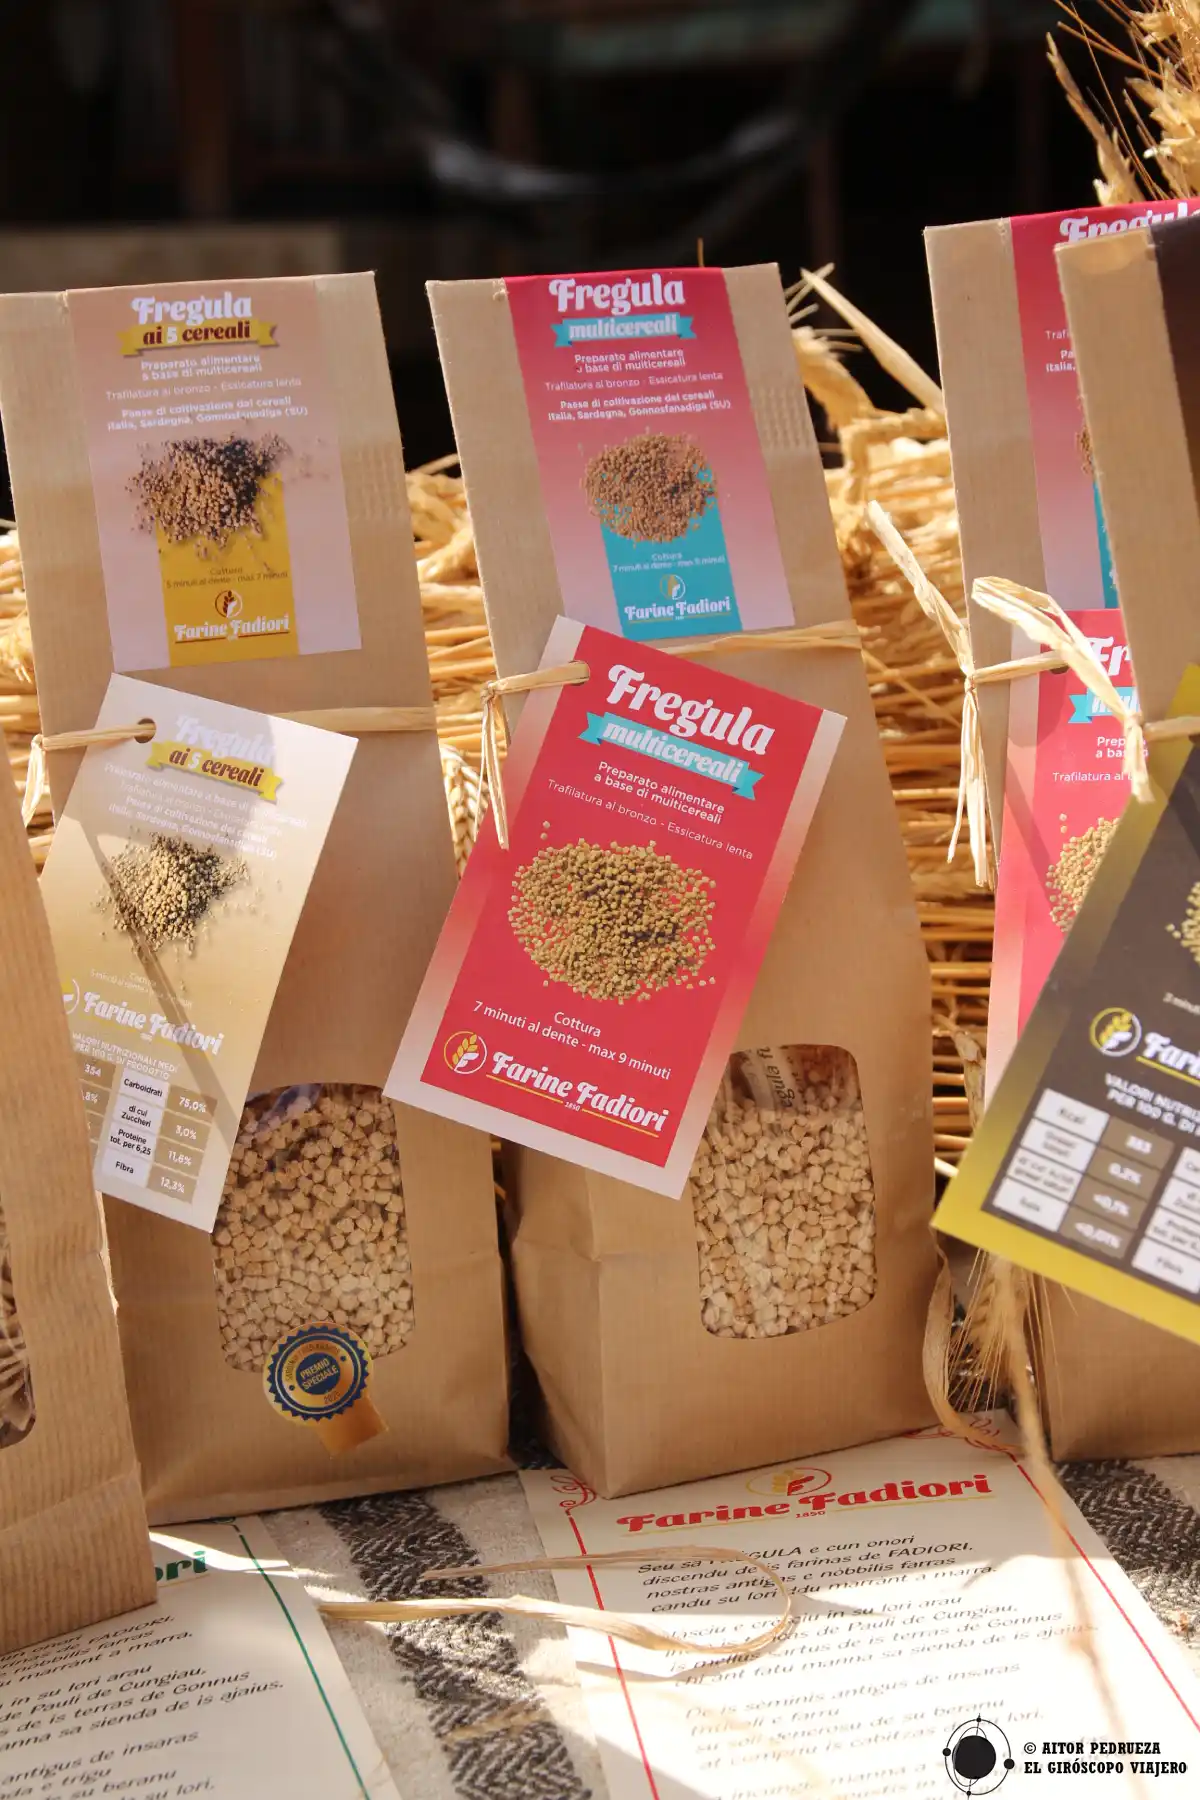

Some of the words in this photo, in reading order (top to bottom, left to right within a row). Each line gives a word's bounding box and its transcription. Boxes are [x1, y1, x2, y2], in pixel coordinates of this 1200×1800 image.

[130, 291, 252, 325] Fregula
[549, 273, 686, 316] Fregula
[143, 326, 162, 344] ai
[167, 327, 177, 343] 5
[182, 320, 250, 342] cereali
[569, 314, 678, 339] multicereali
[141, 358, 197, 372] Preparato
[201, 353, 260, 366] alimentare
[574, 353, 626, 365] Preparato
[629, 348, 684, 361] alimentare
[585, 363, 609, 373] base
[612, 361, 622, 371] di
[625, 357, 686, 370] multicereali
[606, 377, 640, 388] bronzo
[649, 373, 697, 385] Essicatura
[699, 371, 723, 381] lenta
[624, 603, 674, 621] Farine
[675, 596, 731, 617] Fadiori
[174, 621, 229, 642] Farine
[230, 613, 290, 636] Fadiori
[607, 664, 776, 755] Fregula
[602, 721, 744, 784] multicereali
[169, 748, 191, 766] ai
[201, 758, 265, 787] cereali
[1053, 771, 1111, 782] Trafilatura
[1114, 771, 1124, 781] al
[594, 773, 602, 782] a
[604, 774, 633, 793] base
[636, 787, 649, 799] di
[651, 792, 722, 825] multicereali
[599, 760, 658, 790] Preparato
[661, 784, 725, 815] alimentare
[548, 778, 603, 807] Trafilatura
[605, 800, 616, 812] al
[617, 802, 657, 826] bronzo
[667, 821, 724, 849] Essicatura
[726, 842, 754, 861] lenta
[84, 992, 147, 1030] Farine
[150, 1013, 225, 1056] Fadiori
[554, 1011, 602, 1038] Cottura
[473, 1000, 483, 1012] 7
[483, 1004, 527, 1029] minuti
[527, 1021, 541, 1034] al
[541, 1026, 580, 1048] dente
[588, 1042, 617, 1062] max
[618, 1052, 627, 1064] 9
[628, 1057, 672, 1081] minuti
[84, 1063, 101, 1078] 354
[124, 1078, 163, 1098] Carboidrati
[179, 1096, 207, 1113] 75,0%
[492, 1051, 574, 1098] Farine
[576, 1081, 670, 1132] Fadiori
[128, 1104, 136, 1114] di
[118, 1128, 147, 1145] Proteine
[121, 1111, 152, 1129] Zuccheri
[175, 1124, 197, 1140] 3,0%
[110, 1135, 121, 1146] tot.
[122, 1140, 135, 1151] per
[115, 1160, 135, 1175] Fibra
[167, 1150, 193, 1166] 11,6%
[300, 1358, 330, 1379] PREMIO
[302, 1365, 339, 1390] SPECIALE
[616, 1501, 791, 1533] Farine
[798, 1474, 993, 1511] Fadiori
[794, 1509, 827, 1519] 1850
[638, 1561, 675, 1575] Seu
[810, 1545, 819, 1553] e
[826, 1542, 860, 1552] cun
[867, 1535, 915, 1548] onori
[643, 1569, 728, 1586] discendu
[735, 1565, 757, 1575] de
[787, 1553, 852, 1570] farinas
[858, 1551, 881, 1562] de
[888, 1542, 973, 1558] FADIORI.
[646, 1583, 720, 1600] nostras
[803, 1572, 813, 1580] e
[901, 1557, 956, 1570] farras
[651, 1597, 711, 1613] candu
[717, 1594, 740, 1605] su
[747, 1587, 778, 1601] lori
[827, 1609, 845, 1619] in
[851, 1607, 874, 1616] su
[848, 1617, 895, 1632] Pauli
[109, 1650, 121, 1658] a
[129, 1630, 193, 1653] marra.
[11, 1696, 30, 1707] in
[37, 1688, 62, 1700] su
[68, 1675, 102, 1693] lori
[106, 1665, 152, 1683] arau
[17, 1720, 42, 1733] de
[50, 1713, 67, 1725] is
[74, 1697, 135, 1719] terras
[140, 1690, 165, 1703] de
[173, 1671, 250, 1696] Gonnus
[30, 1693, 82, 1715] Pauli
[87, 1688, 112, 1701] de
[58, 1725, 82, 1739] sa
[90, 1707, 157, 1731] sienda
[165, 1700, 190, 1713] de
[197, 1694, 214, 1706] is
[220, 1680, 284, 1704] ajaius.
[1, 1757, 82, 1787] antigus
[90, 1750, 115, 1764] de
[123, 1730, 199, 1757] insaras
[62, 1767, 112, 1787] trigu
[103, 1769, 177, 1794] beranu
